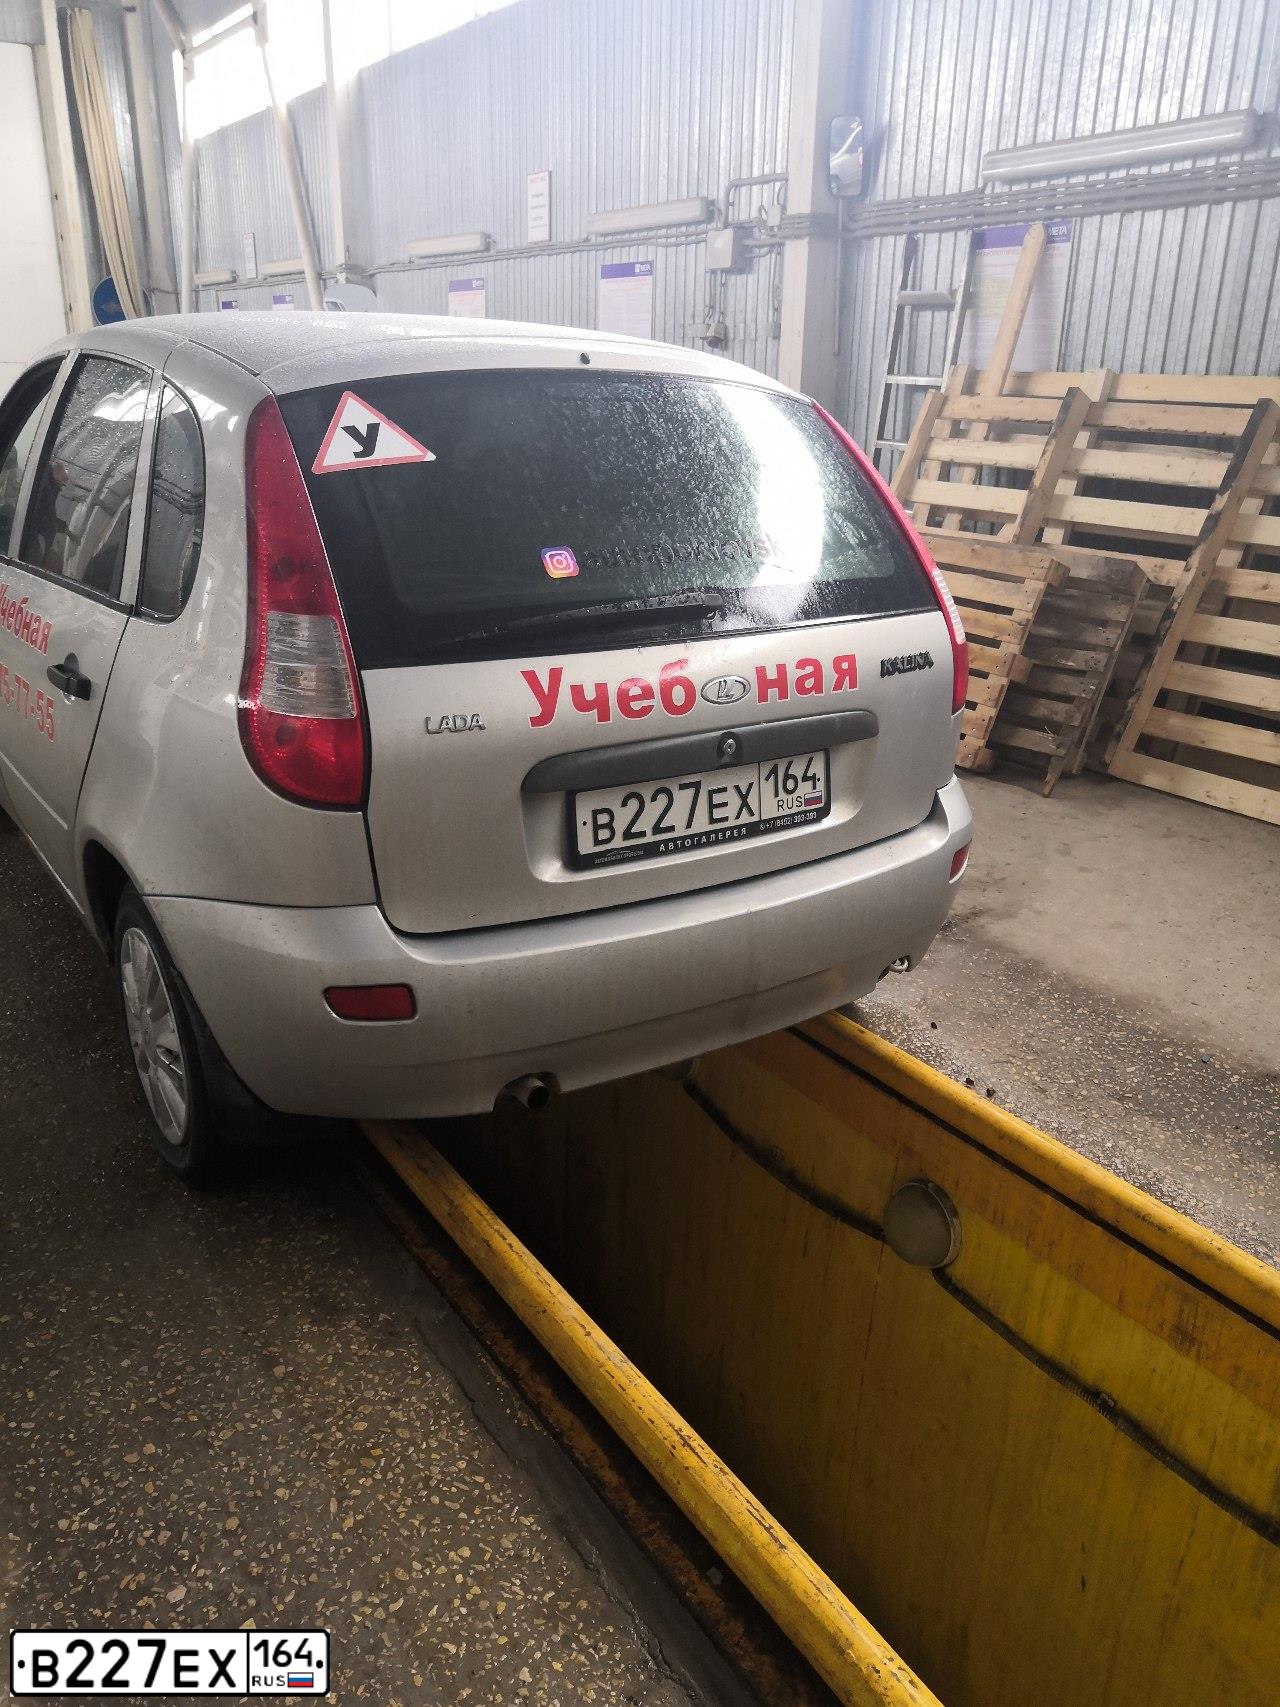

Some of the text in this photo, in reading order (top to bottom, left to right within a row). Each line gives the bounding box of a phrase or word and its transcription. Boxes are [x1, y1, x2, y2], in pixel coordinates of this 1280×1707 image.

[340, 422, 380, 458] У
[425, 713, 486, 735] LADA
[764, 756, 818, 799] 164
[777, 795, 803, 813] RUS
[659, 827, 748, 852] АВТОГАЛЕРЕЯ
